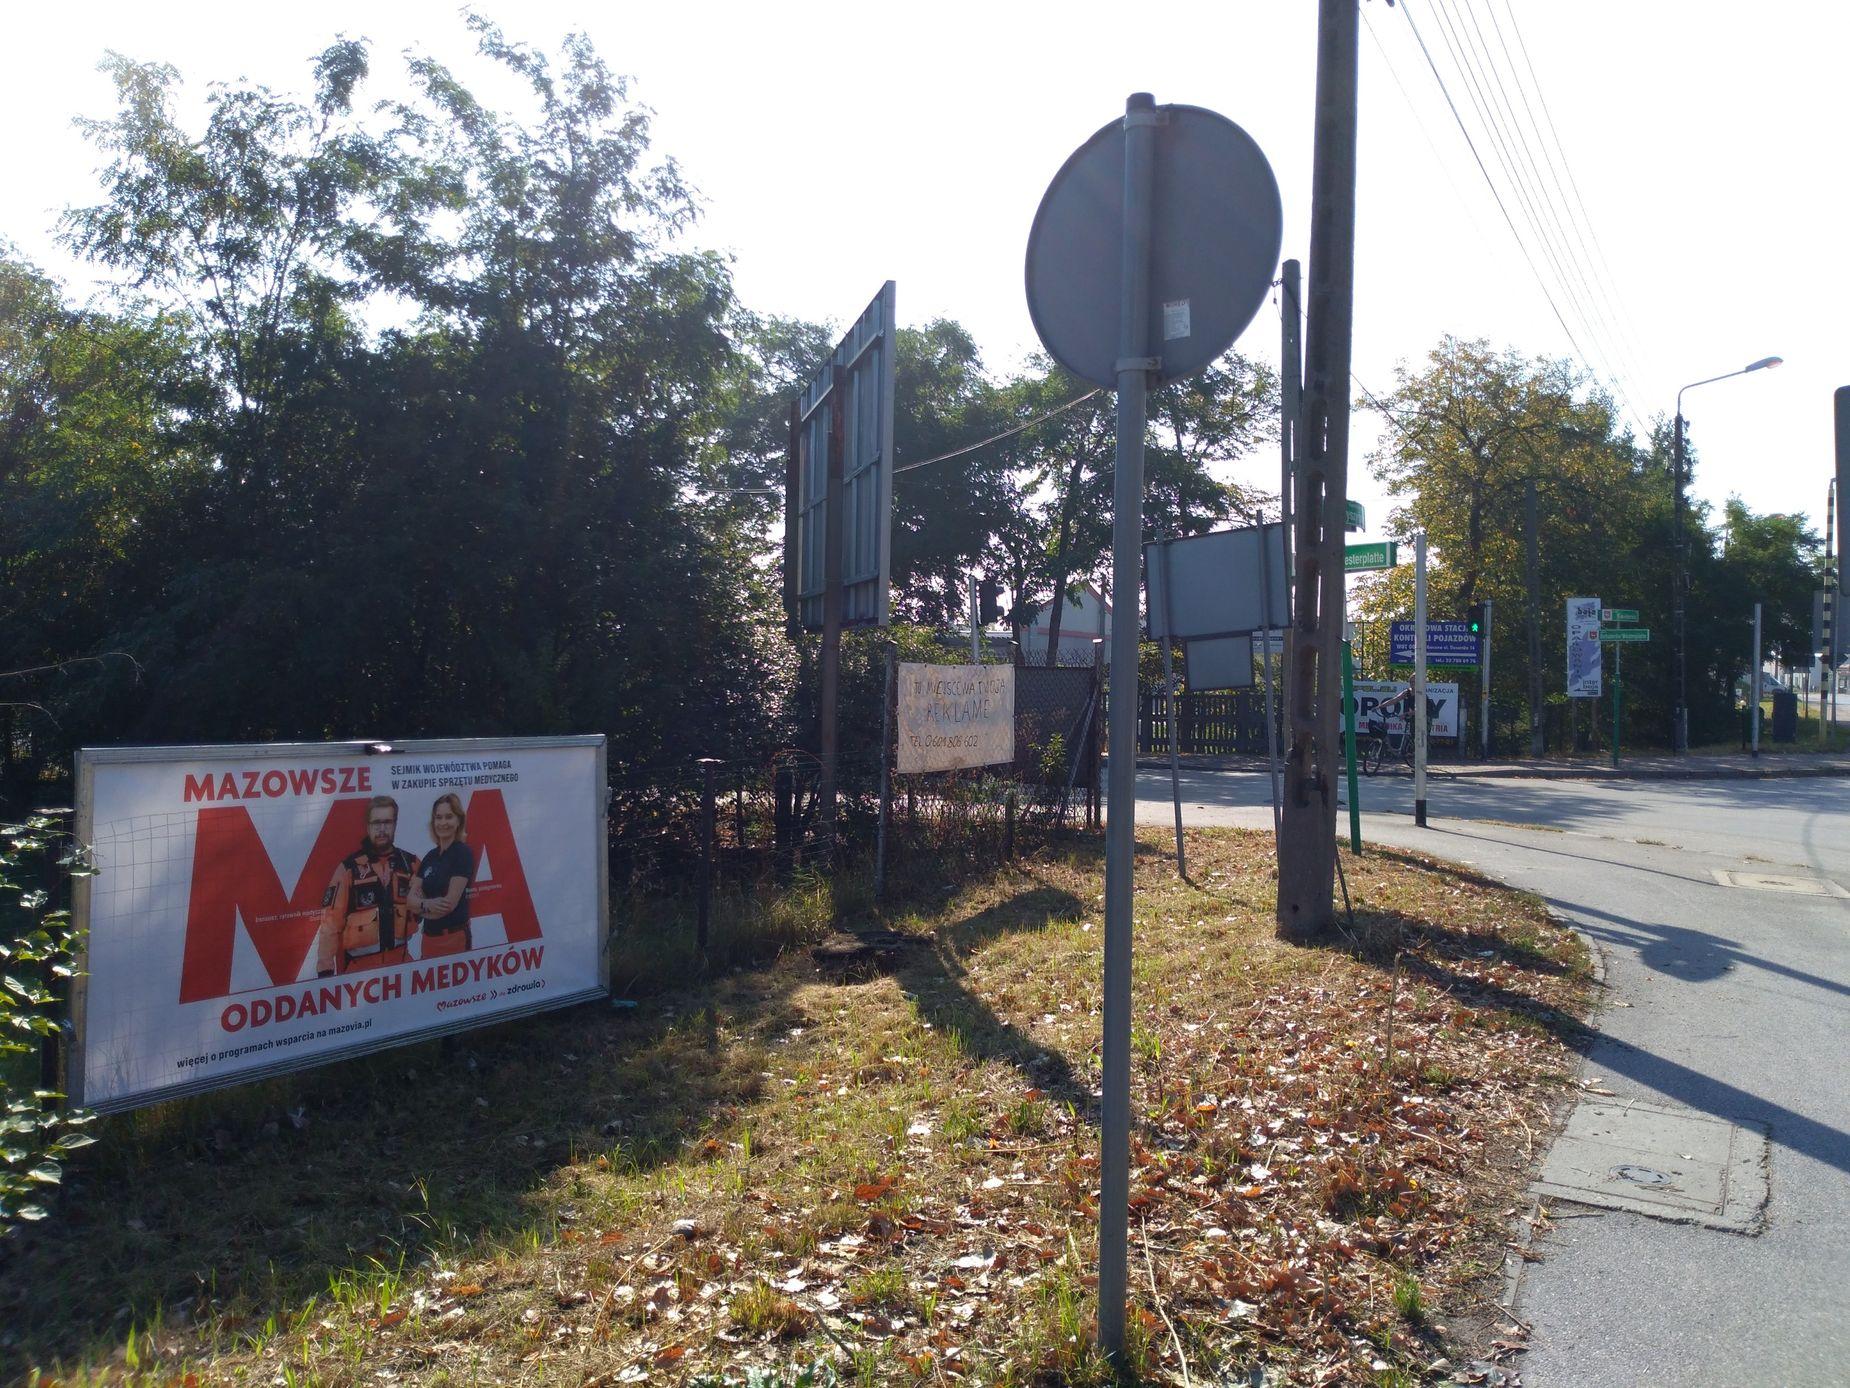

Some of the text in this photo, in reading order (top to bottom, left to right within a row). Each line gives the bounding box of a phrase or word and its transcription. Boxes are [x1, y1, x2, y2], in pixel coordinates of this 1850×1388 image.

[1344, 552, 1384, 566] esterplatte
[1399, 624, 1469, 632] OKROWA STACJ
[1433, 632, 1476, 643] POJAZDÓW
[391, 760, 512, 776] SEJMIK WOJEWÓDZTWA POMAGA
[184, 766, 373, 802] MAZOWSZE
[392, 773, 519, 790] W ZAKUPIE SPRZĘTU MEDYCZNEGO
[220, 945, 545, 1033] ODDANYCH MEDYKÓW
[507, 980, 541, 995] zdrowia
[176, 1018, 373, 1069] więcej o programach wsparcia na mazovia.pl
